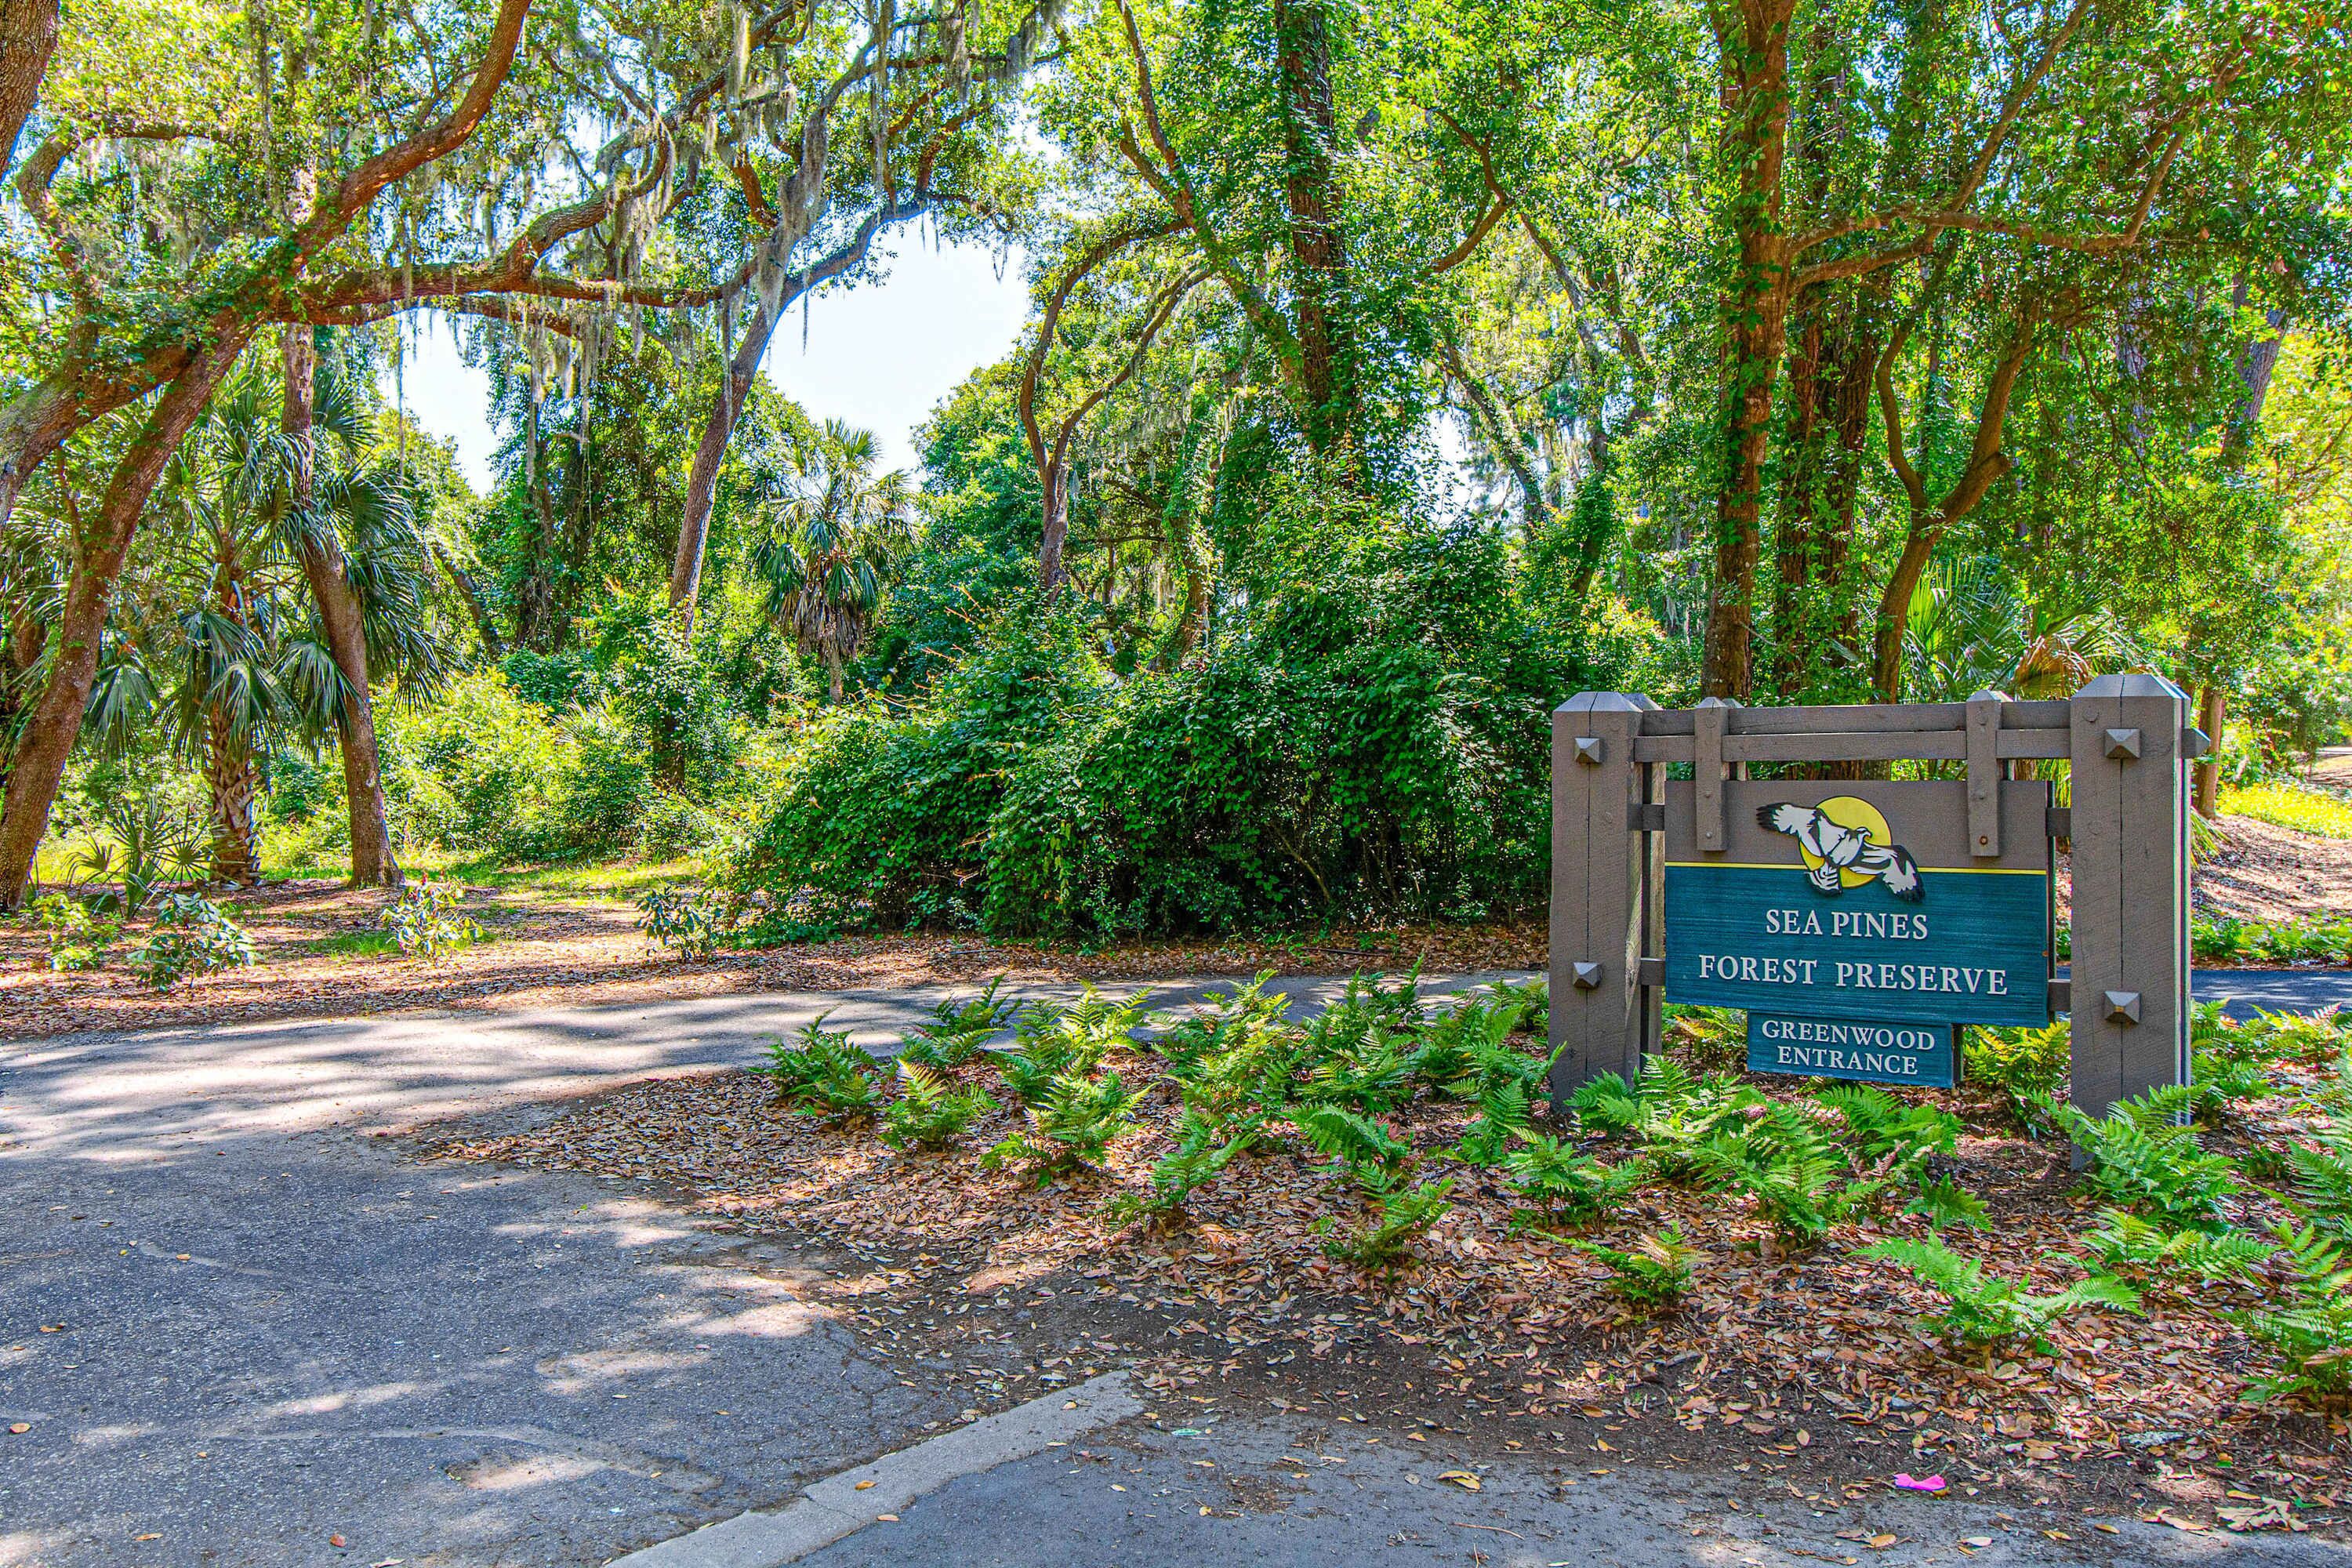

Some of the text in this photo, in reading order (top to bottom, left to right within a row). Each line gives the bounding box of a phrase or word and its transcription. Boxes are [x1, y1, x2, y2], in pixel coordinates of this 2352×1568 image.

[1766, 909, 1929, 940] SEA PINES
[1698, 954, 2009, 995] FOREST PRESERVE
[1761, 1020, 1936, 1051] GREENWOOD
[1777, 1045, 1918, 1076] ENTRANCE
